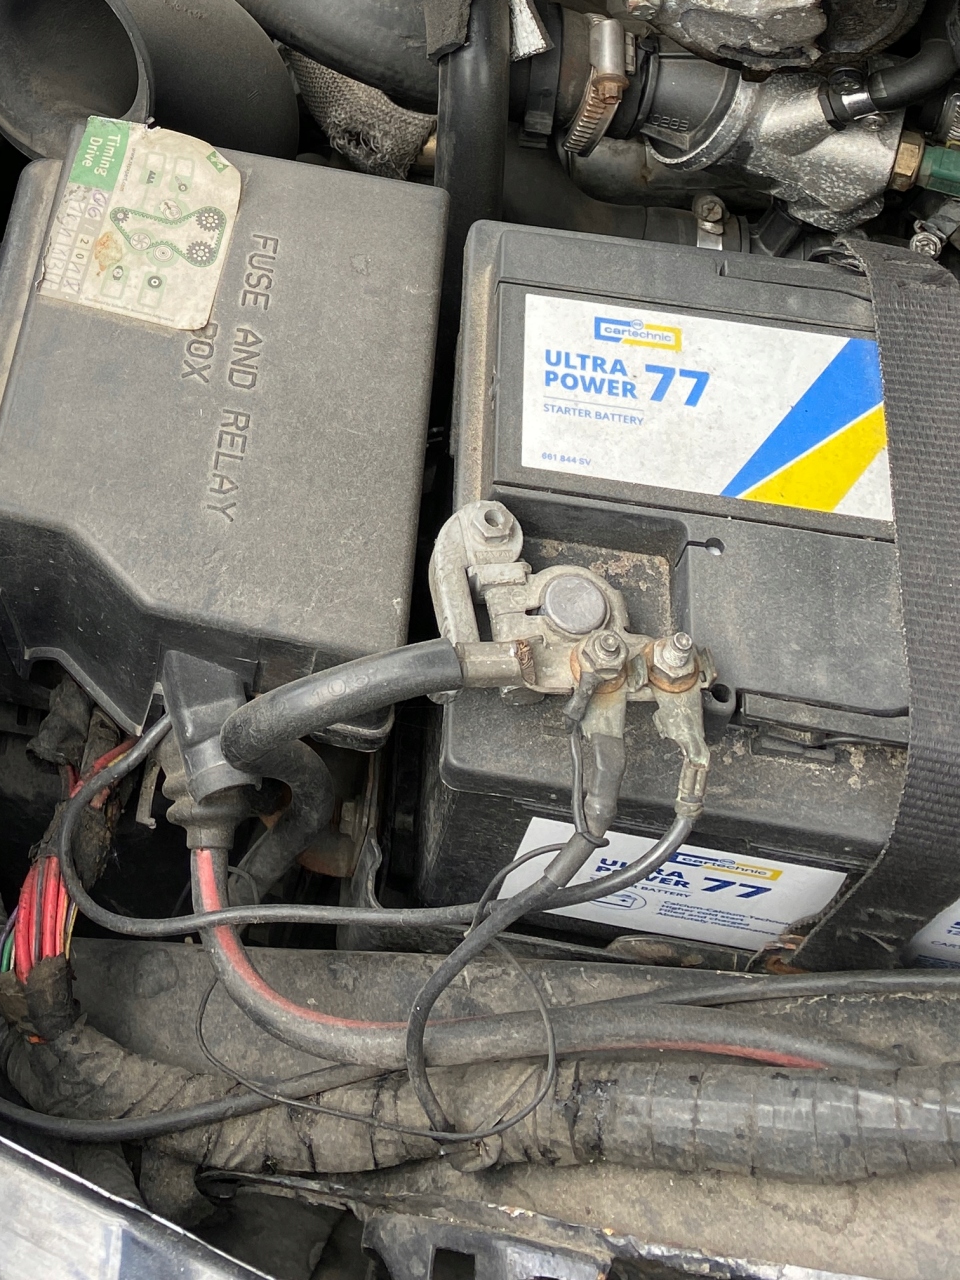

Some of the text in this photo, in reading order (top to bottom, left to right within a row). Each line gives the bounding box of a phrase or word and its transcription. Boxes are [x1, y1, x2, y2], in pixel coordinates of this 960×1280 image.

[82, 136, 104, 167] Drive
[93, 134, 121, 177] Timing
[604, 326, 672, 342] cartechnic
[545, 349, 628, 377] ULTRA
[206, 232, 280, 524] FUSE AND RELAY
[544, 370, 638, 399] POWER
[644, 364, 710, 408] 77
[543, 403, 644, 427] STARTER BATTERY
[541, 451, 592, 467] 661 844 SV
[681, 858, 768, 876] cartechnic
[640, 885, 692, 898] BATTERY
[701, 876, 772, 899] 77
[657, 912, 709, 924] Absolutely
